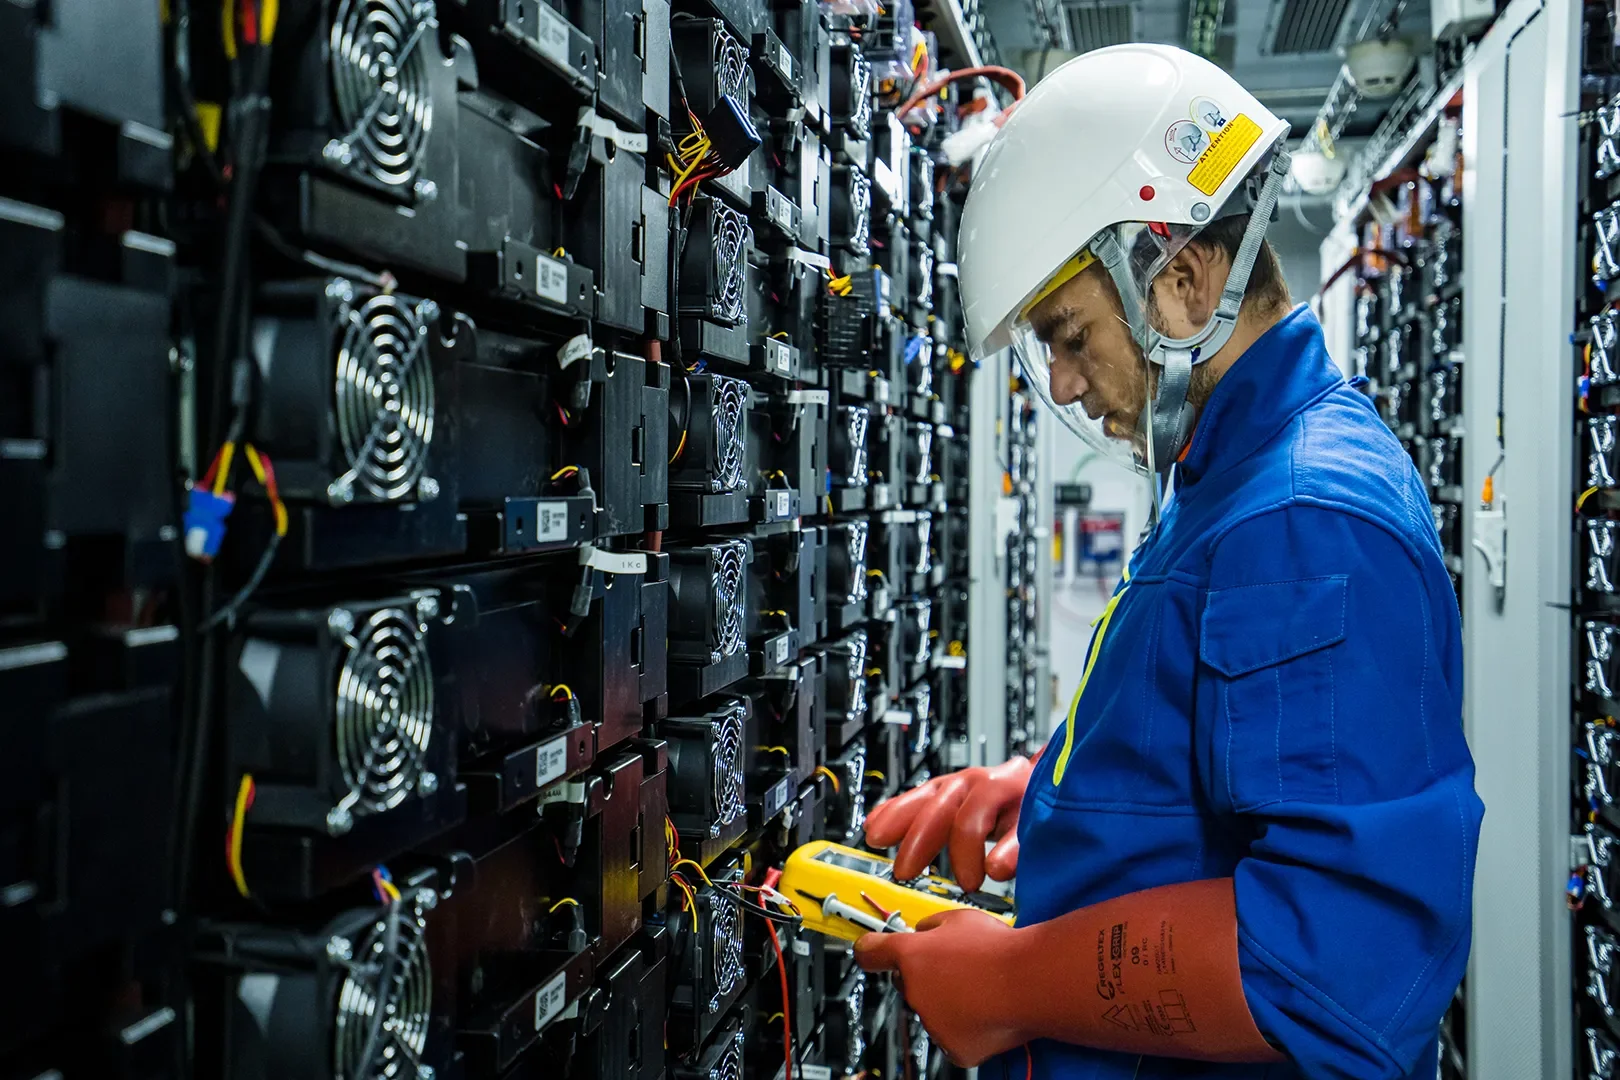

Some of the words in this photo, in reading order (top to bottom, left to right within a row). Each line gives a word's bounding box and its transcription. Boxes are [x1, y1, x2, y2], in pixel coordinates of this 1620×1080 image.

[1199, 122, 1234, 164] ATTENTION
[1097, 929, 1107, 987] REGELTEX
[1111, 924, 1123, 959] GRIP
[1130, 946, 1140, 965] 09
